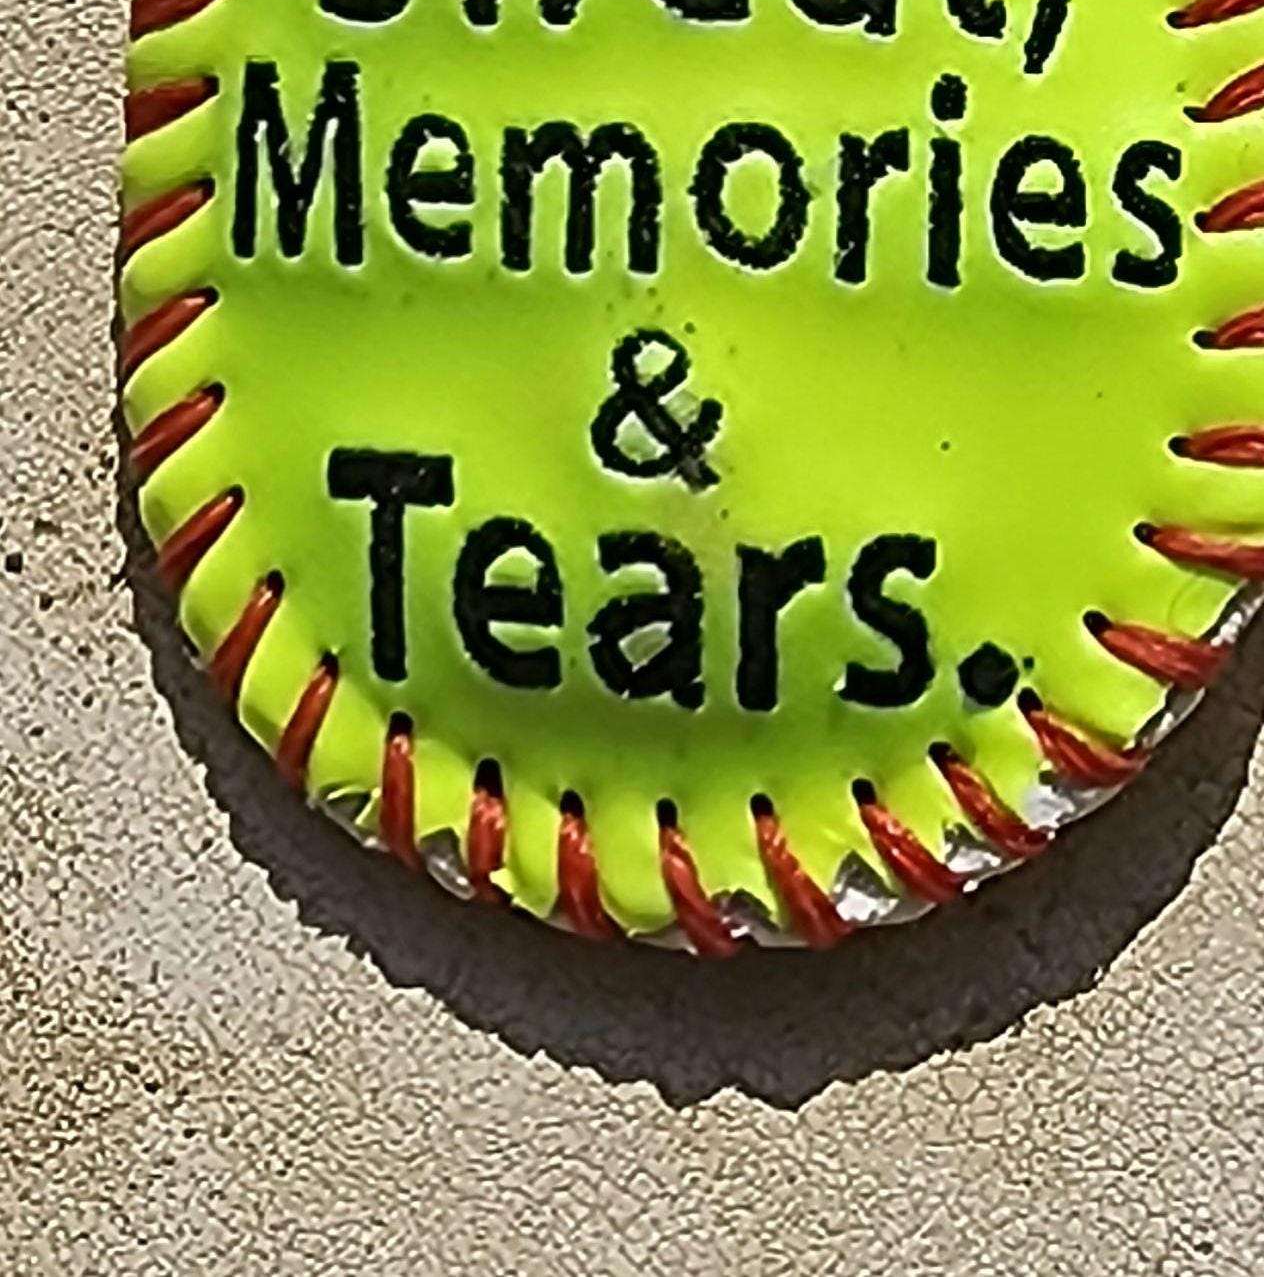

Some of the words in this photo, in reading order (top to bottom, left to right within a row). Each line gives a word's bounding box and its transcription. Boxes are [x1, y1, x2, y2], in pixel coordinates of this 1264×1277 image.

[231, 61, 1184, 288] Memories
[590, 328, 723, 491] &
[327, 448, 1020, 714] Tears.
